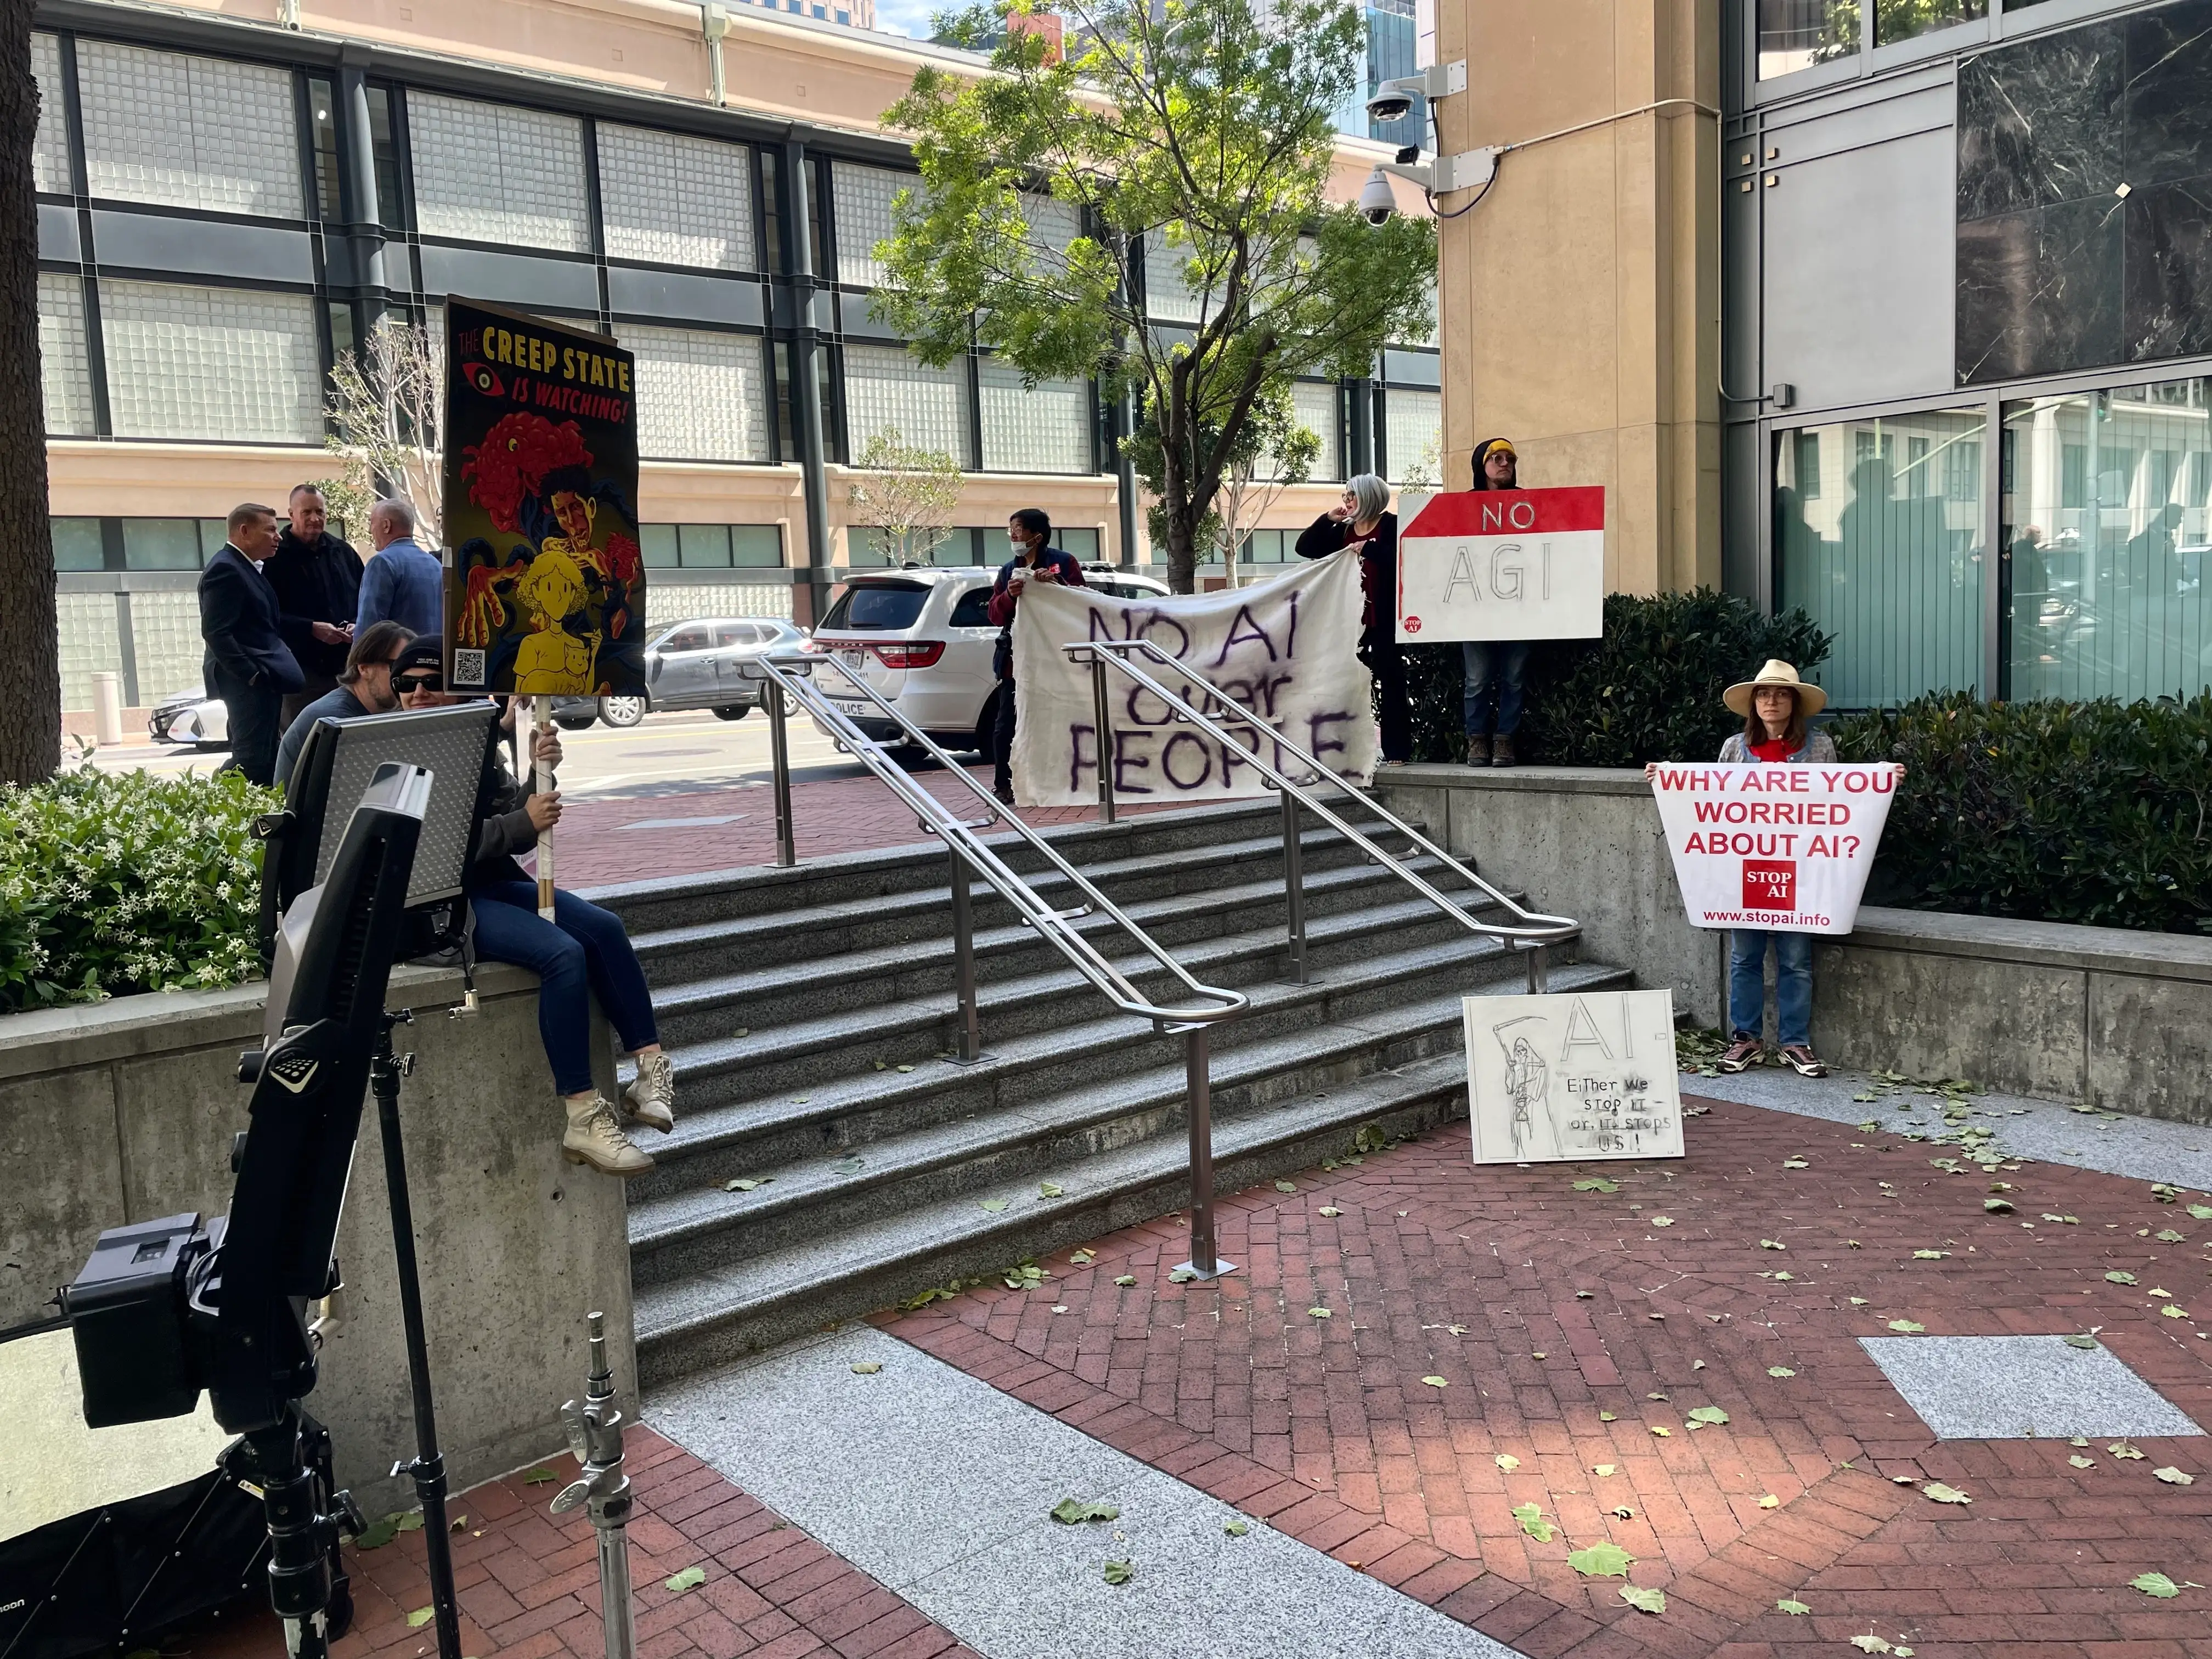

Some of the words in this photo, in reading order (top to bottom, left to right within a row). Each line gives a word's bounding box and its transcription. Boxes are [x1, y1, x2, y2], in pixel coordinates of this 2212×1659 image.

[459, 328, 479, 356] THE
[482, 326, 557, 374] CREEP
[563, 347, 630, 393] STATE
[512, 377, 528, 403] IS
[535, 380, 629, 424] WATCHING!
[1482, 501, 1536, 532] NO
[1442, 543, 1551, 603] AGI
[1088, 606, 1189, 670] NO
[1211, 590, 1301, 667] AI
[1070, 713, 1364, 793] PEOPLE
[1658, 770, 1734, 792] WHY
[1740, 770, 1810, 793] ARE
[1820, 771, 1893, 794] YOU
[1694, 802, 1851, 826] WORRIED
[1684, 832, 1799, 857] ABOUT
[1806, 834, 1861, 859] AI?
[1746, 871, 1792, 884] STOP
[1767, 885, 1788, 899] AI
[1703, 910, 1831, 927] www.stopai.info
